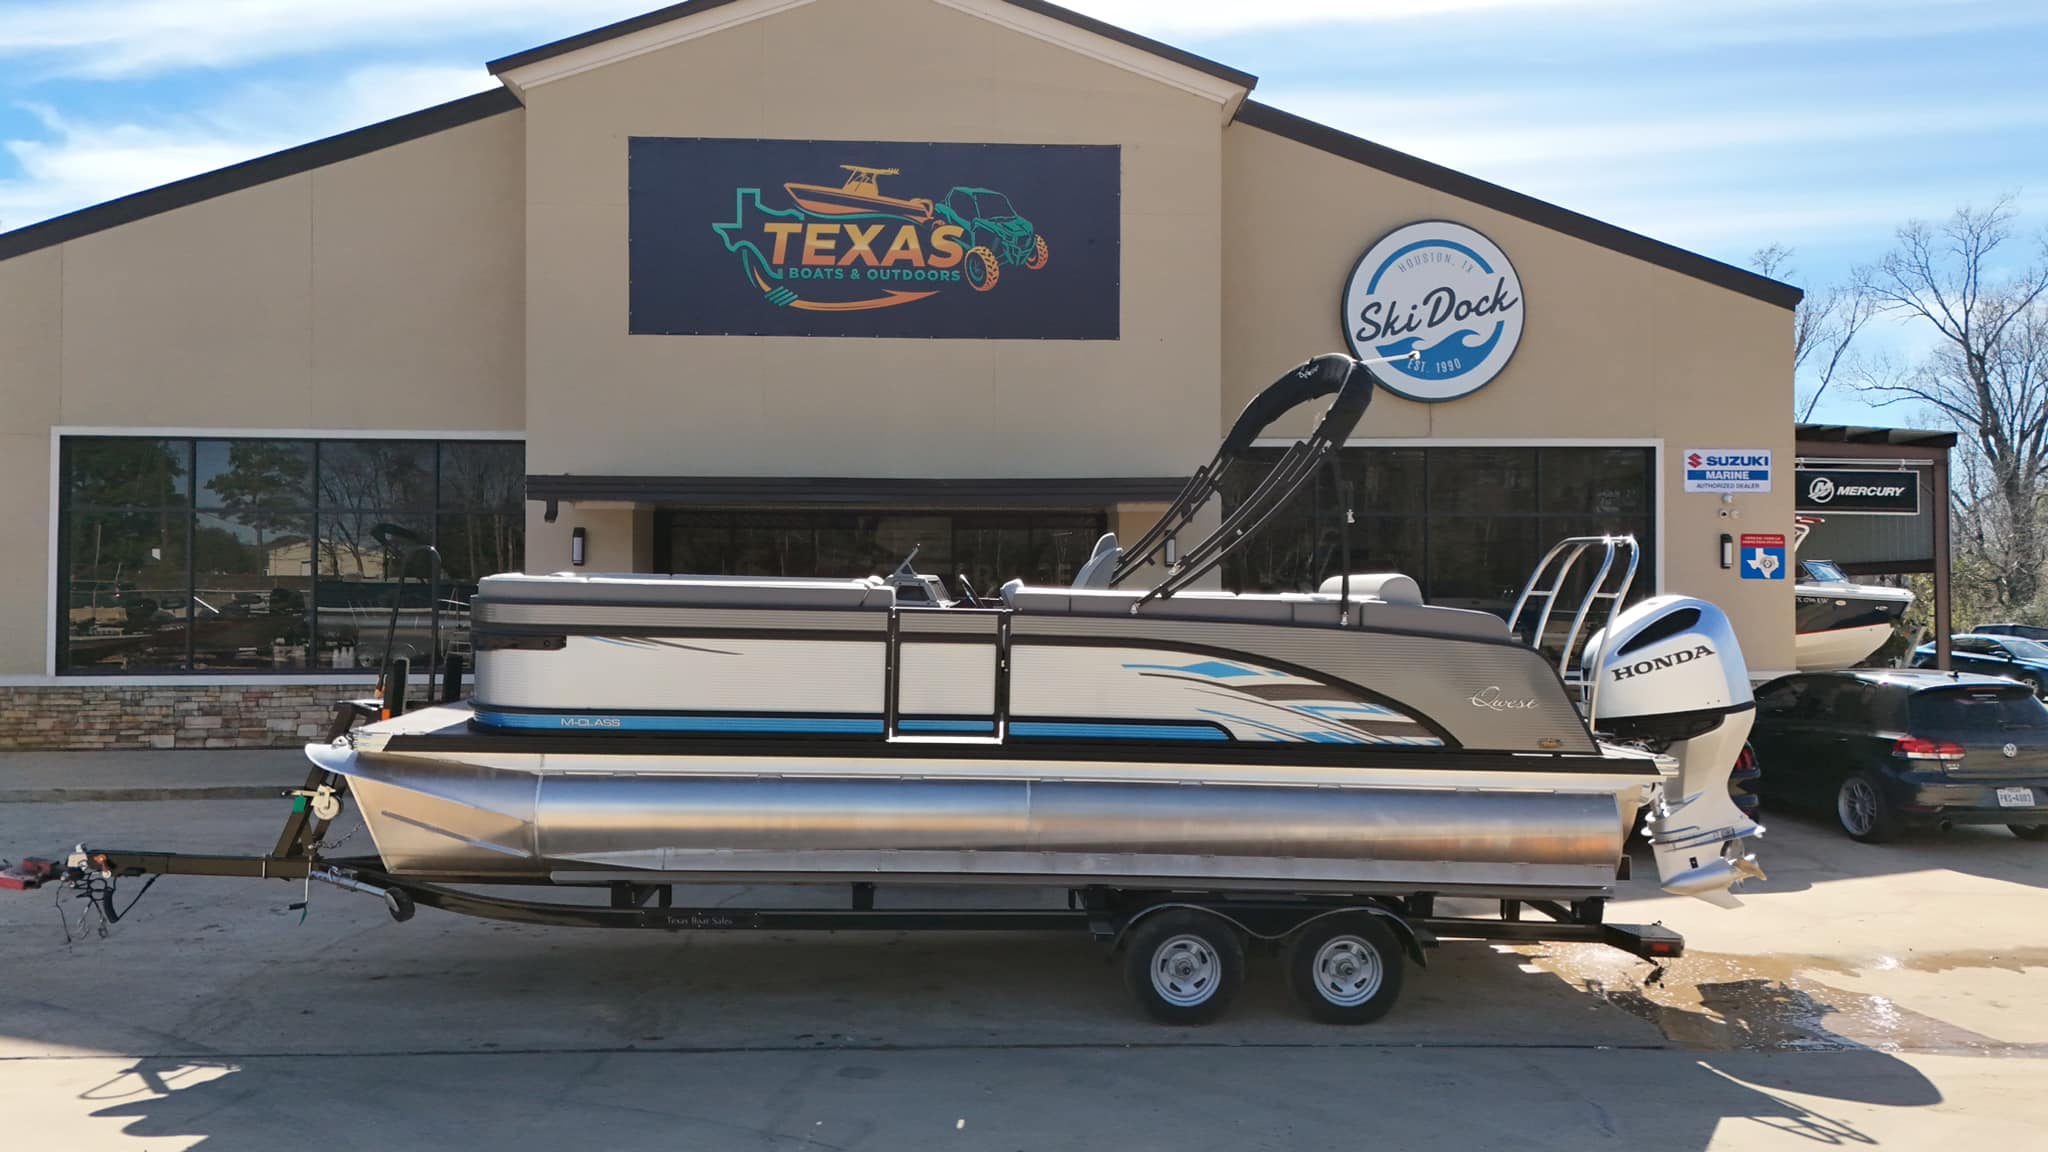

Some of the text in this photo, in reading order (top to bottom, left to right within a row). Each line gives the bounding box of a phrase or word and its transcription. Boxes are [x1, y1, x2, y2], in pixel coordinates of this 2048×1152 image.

[763, 222, 965, 269] TEXAS
[789, 267, 961, 282] BOATS & OUTDOORS
[1356, 276, 1519, 342] Ski Dock
[1436, 358, 1462, 374] 1990
[1705, 455, 1769, 467] SUZUKI
[1705, 470, 1750, 481] MARINE
[1836, 486, 1905, 497] MERCURY
[1611, 645, 1716, 682] HONDA
[1467, 685, 1539, 711] Qwest
[560, 717, 621, 727] M-CLASS
